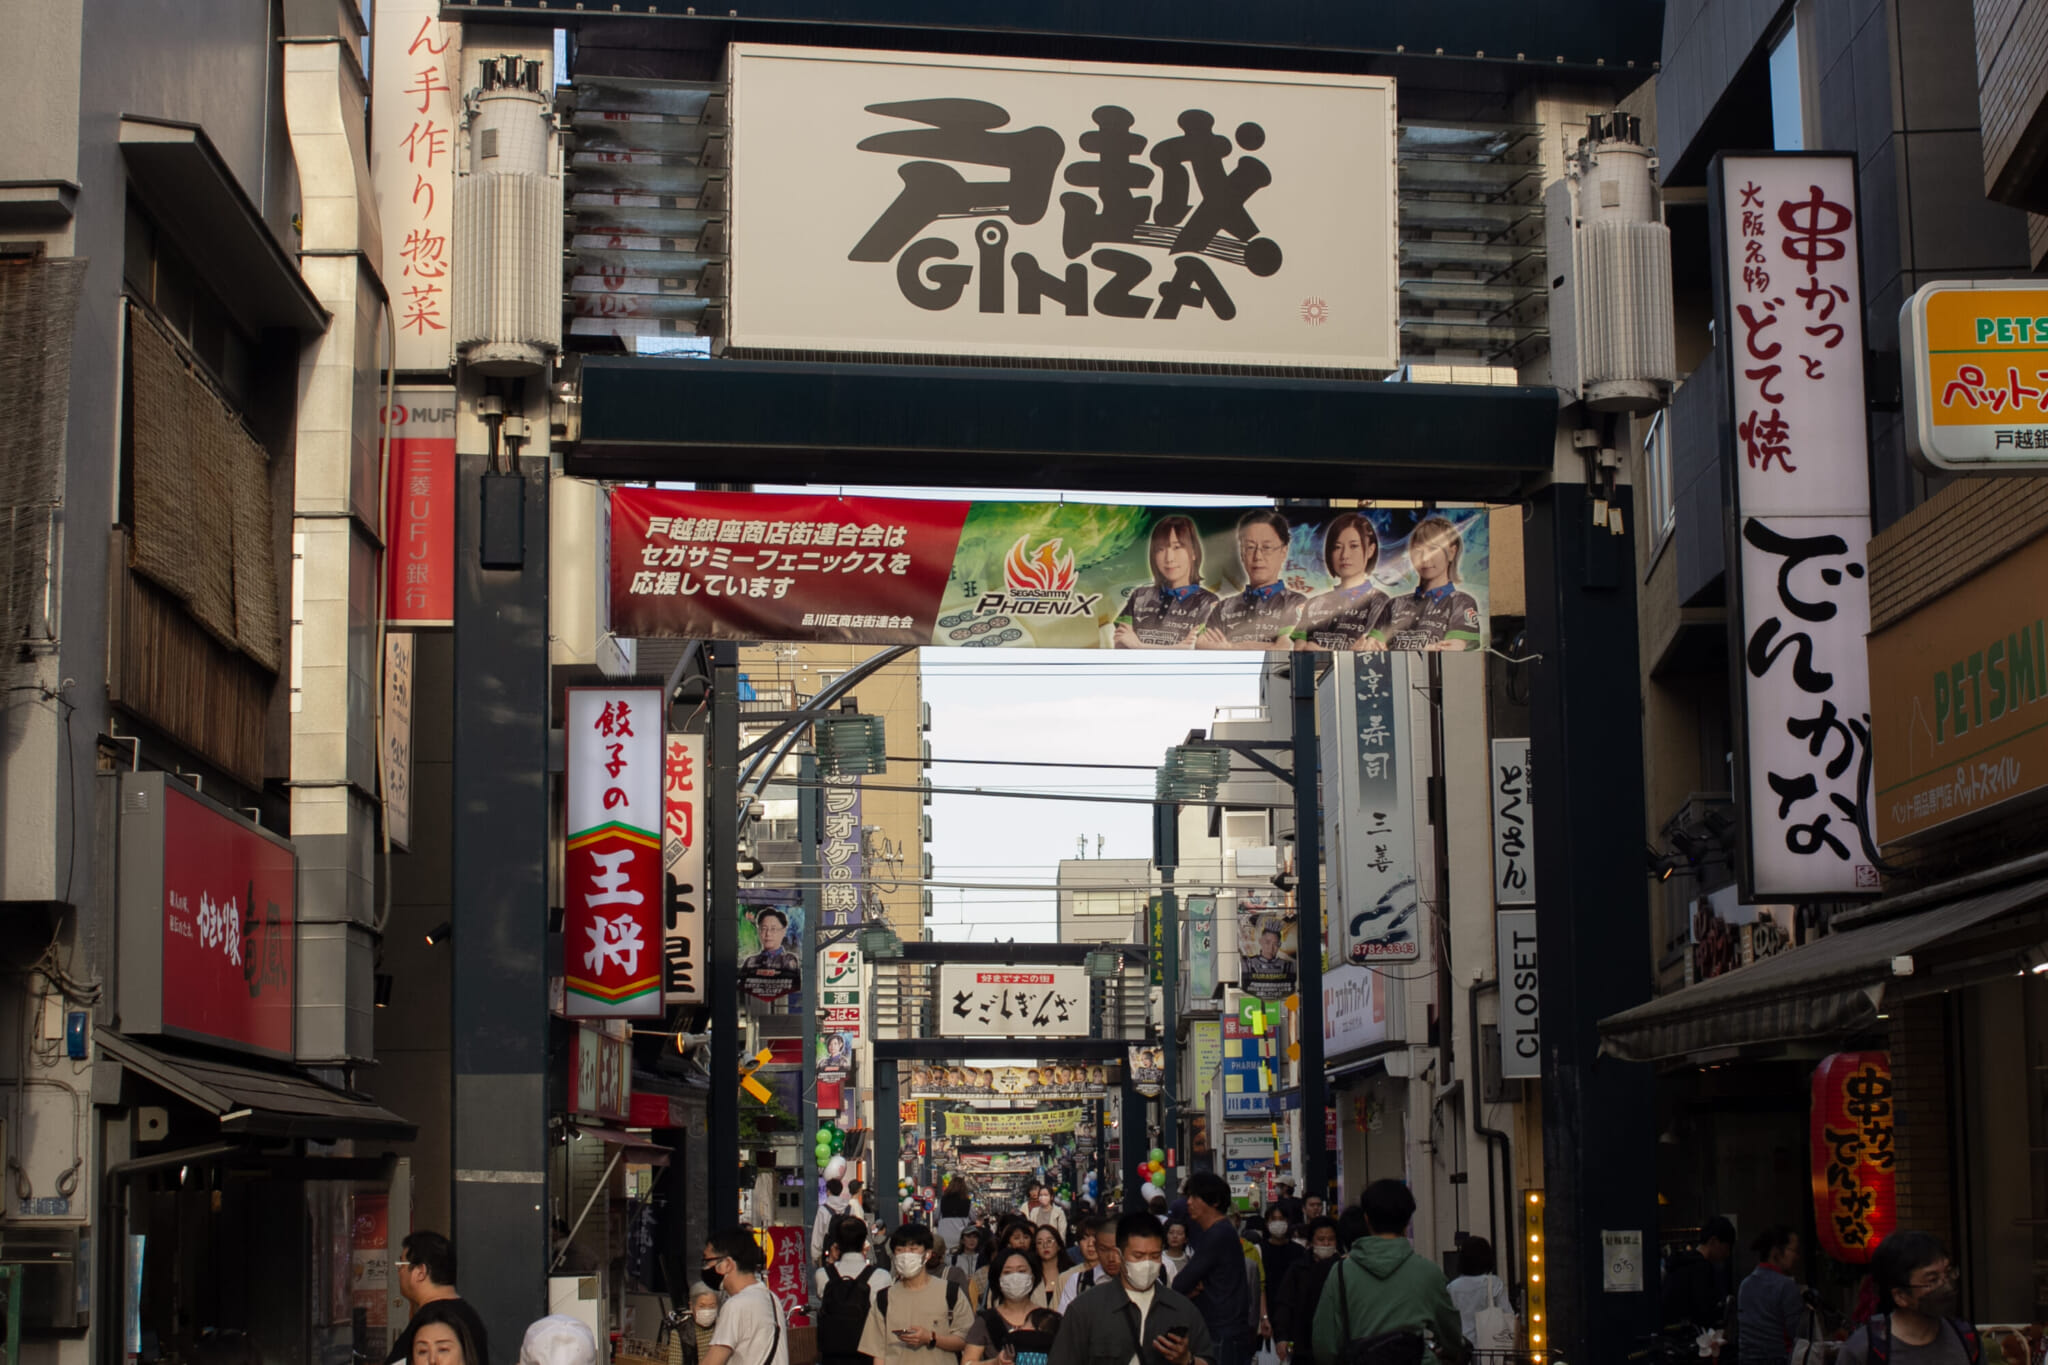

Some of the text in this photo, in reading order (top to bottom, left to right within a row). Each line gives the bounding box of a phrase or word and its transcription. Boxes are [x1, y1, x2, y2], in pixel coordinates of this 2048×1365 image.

[848, 96, 1283, 277] 戸越
[411, 407, 456, 423] MUF
[405, 451, 432, 609] 三菱UFJ銀行
[645, 516, 908, 548] 戸越銀座商店街連合会は
[629, 571, 795, 599] 応援しています
[640, 544, 911, 576] セガサミーフェニックスを
[801, 613, 914, 629] 品川区商店街連合会
[975, 593, 1101, 616] PHOENIX
[1744, 516, 1872, 862] でんがな
[594, 700, 634, 810] 餃子の
[1954, 756, 2021, 807] ペットスマイル
[822, 775, 858, 939] ラオケの鉄人
[1367, 812, 1394, 873] 三善
[196, 889, 242, 966] やきとり家
[584, 848, 645, 977] 王将
[1353, 942, 1416, 957] 3782-3343
[980, 974, 1051, 984] 好きですこの街
[1513, 931, 1539, 1058] CLOSET
[952, 989, 1077, 1027] とごしぎんざ
[1825, 1127, 1871, 1246] でんがな
